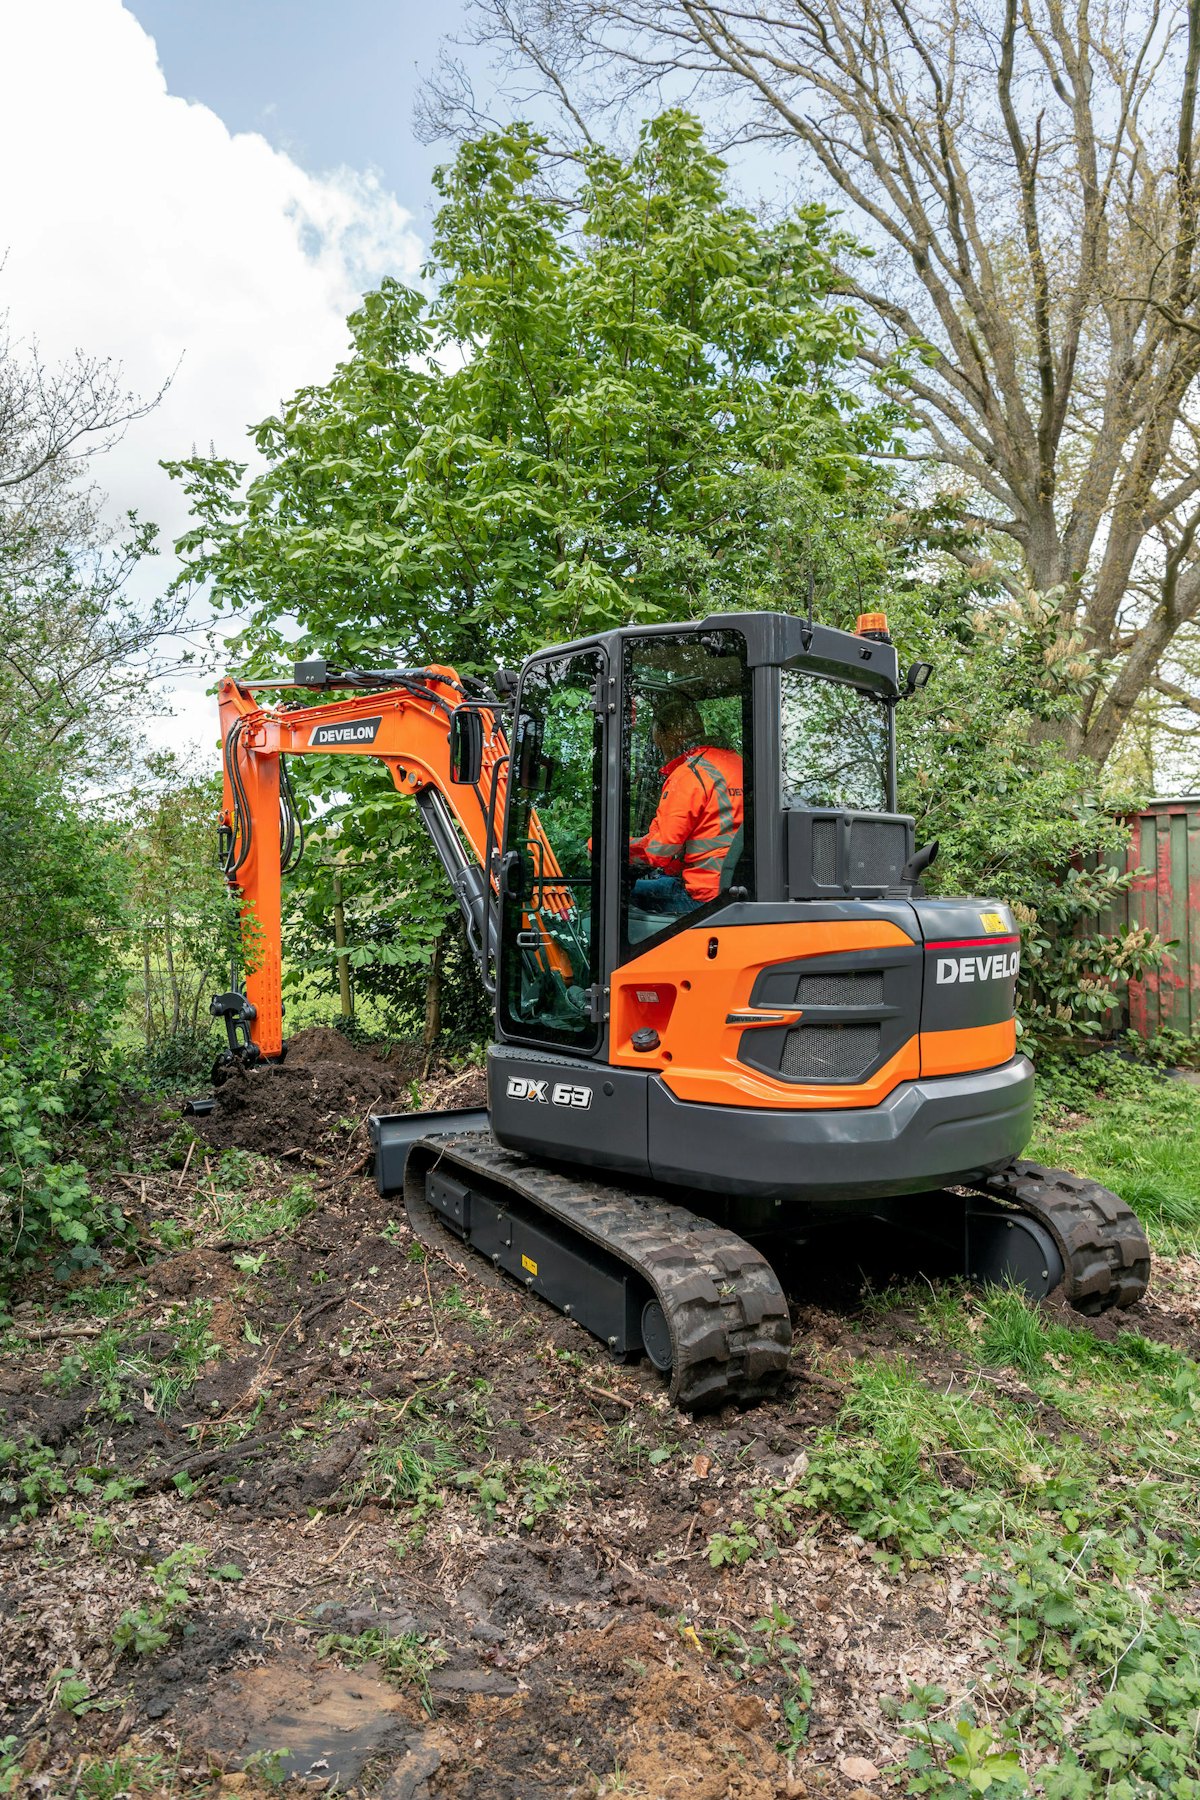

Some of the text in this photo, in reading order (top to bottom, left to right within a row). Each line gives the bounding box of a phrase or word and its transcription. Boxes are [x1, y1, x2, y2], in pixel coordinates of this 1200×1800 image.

[319, 726, 374, 743] DEVELON
[507, 1076, 593, 1110] DX 63
